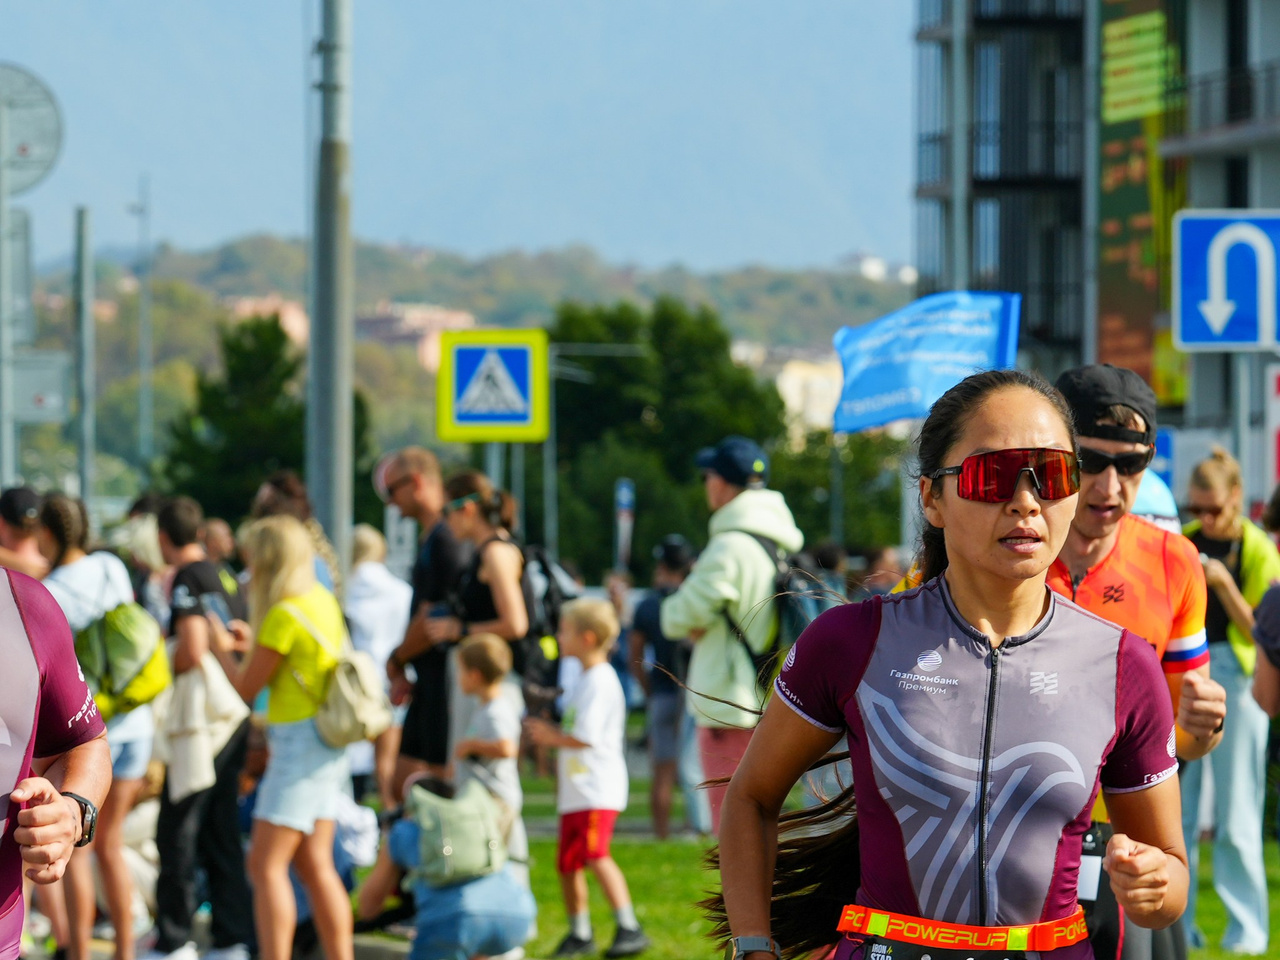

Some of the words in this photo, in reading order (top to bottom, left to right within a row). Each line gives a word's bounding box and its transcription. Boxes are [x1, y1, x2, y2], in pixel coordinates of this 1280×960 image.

[889, 669, 959, 686] Газпромбанк
[897, 680, 947, 695] Премиум
[887, 918, 1007, 947] POWERUP
[871, 943, 887, 954] IRON
